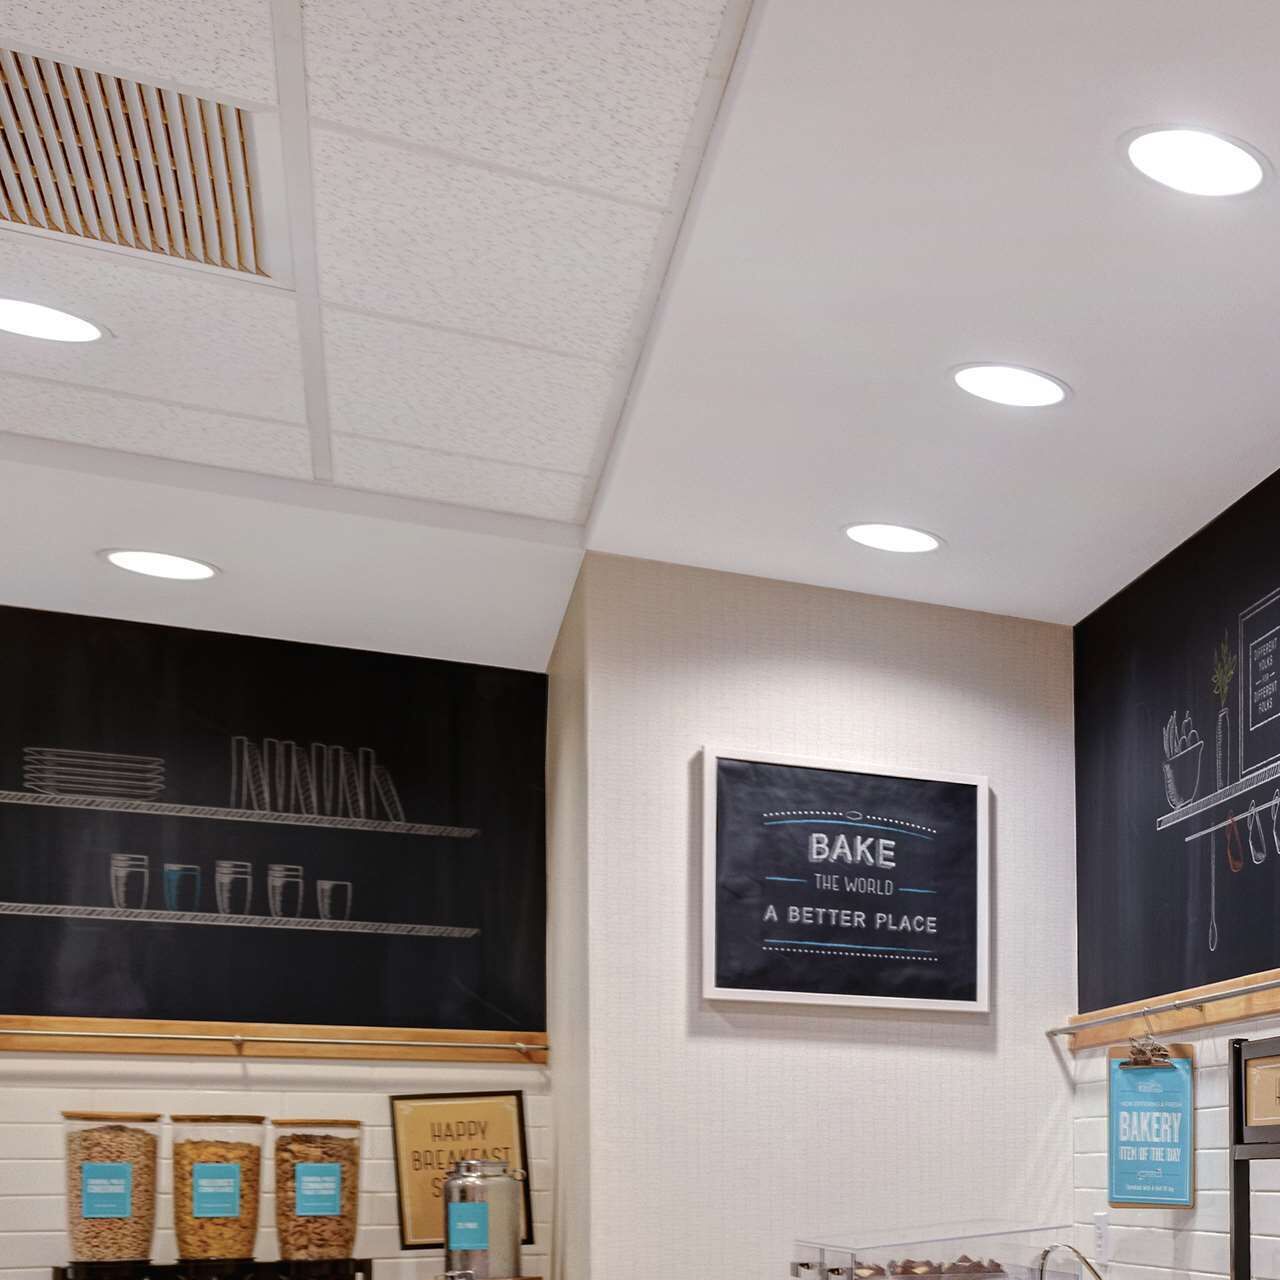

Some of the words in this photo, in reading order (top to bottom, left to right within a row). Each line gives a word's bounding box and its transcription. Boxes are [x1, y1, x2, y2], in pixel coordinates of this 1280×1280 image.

[808, 833, 897, 869] BAKE
[814, 873, 840, 892] THE
[844, 876, 894, 896] WORLD
[763, 904, 778, 923] A
[787, 905, 866, 928] BETTER
[875, 913, 938, 934] PLACE
[430, 1121, 488, 1142] HAPPY
[1119, 1111, 1182, 1143] BAKERY
[1151, 1147, 1165, 1162] THE
[1167, 1147, 1181, 1162] DAY
